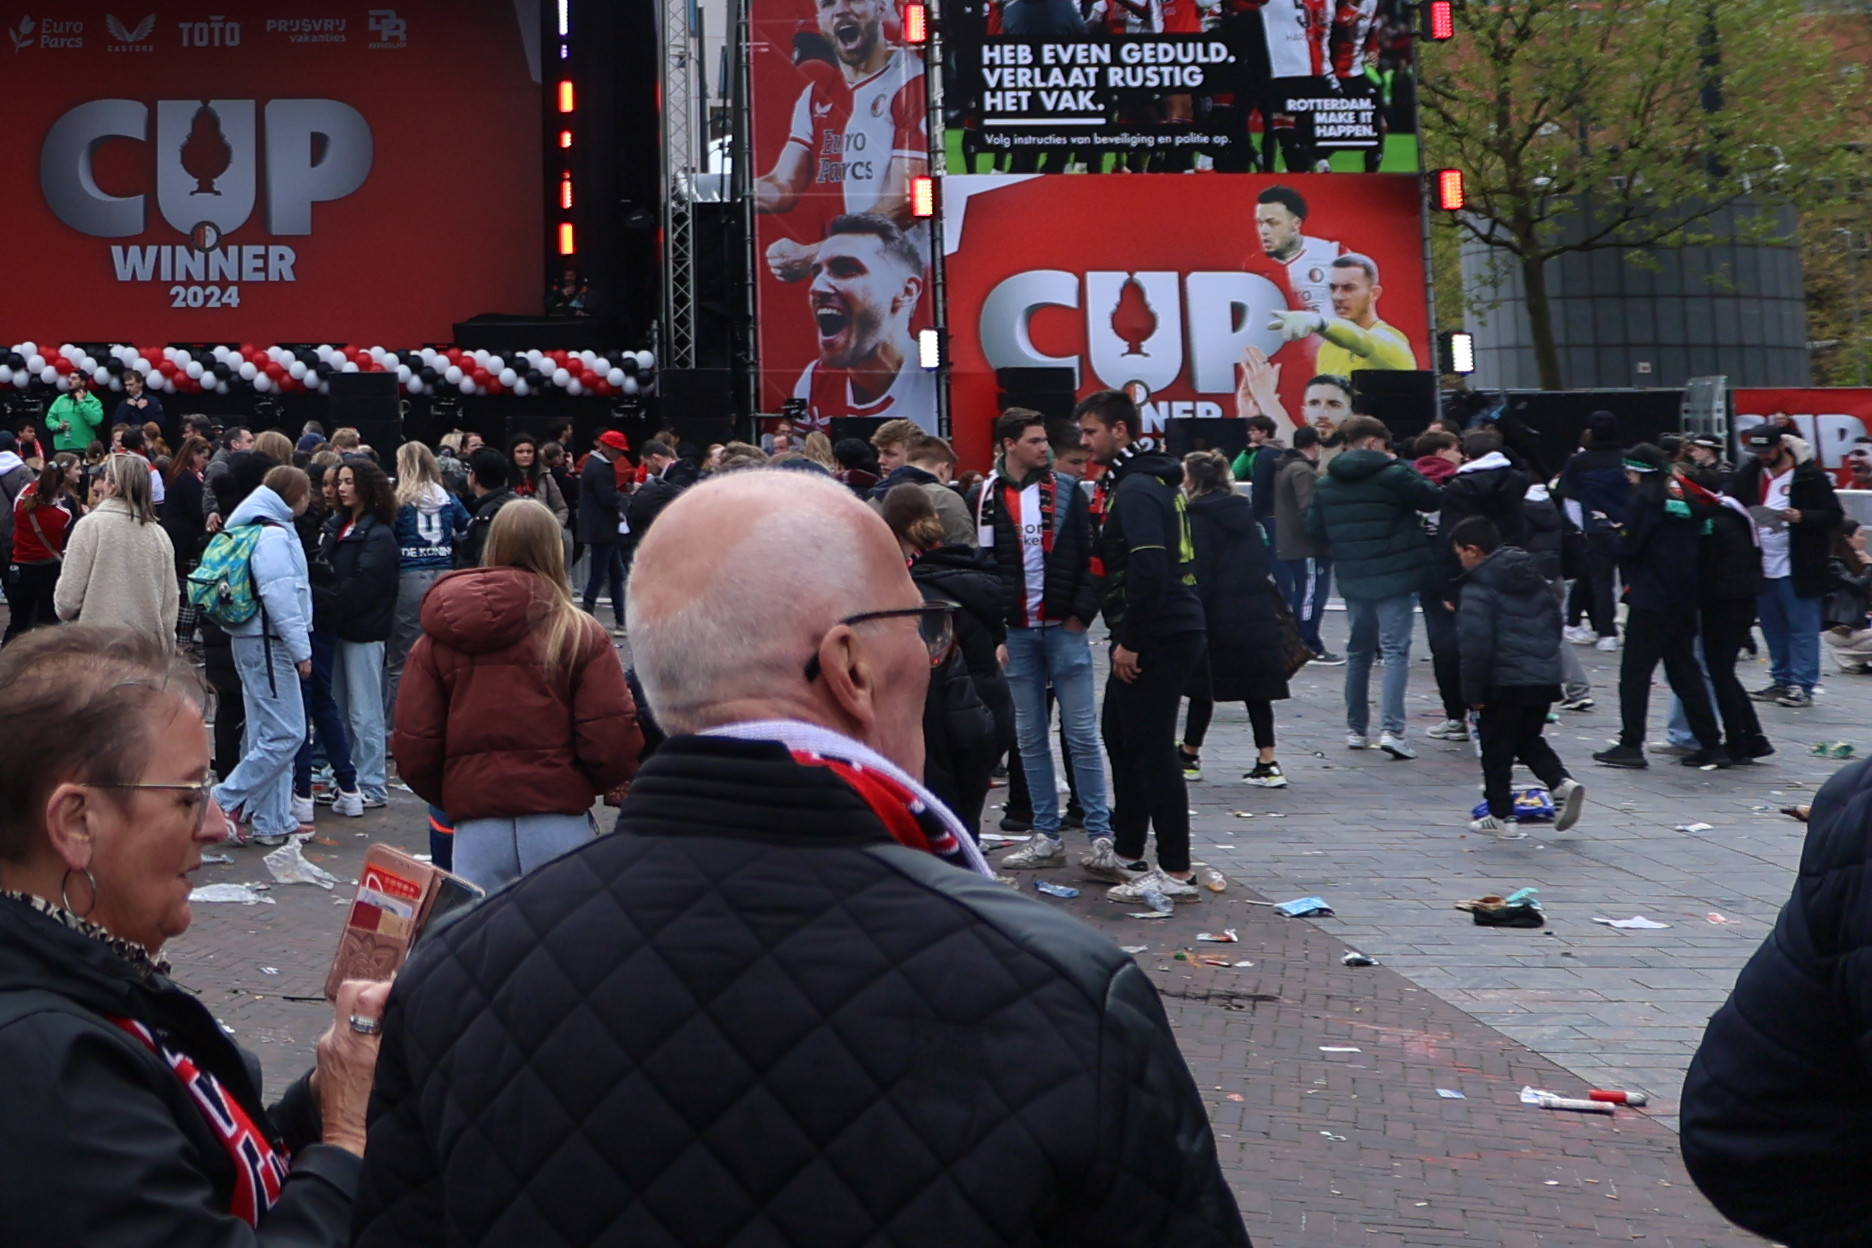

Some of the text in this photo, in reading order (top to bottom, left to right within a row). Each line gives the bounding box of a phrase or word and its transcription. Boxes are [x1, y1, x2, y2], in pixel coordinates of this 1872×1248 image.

[40, 18, 84, 35] Euro
[39, 34, 84, 49] Parcs
[289, 32, 347, 44] vakanties
[982, 42, 1236, 65] HEB EVEN GEDULD.
[982, 65, 1204, 88] VERLAAT RUSTIG
[984, 90, 1105, 112] HET VAK.
[1286, 98, 1376, 112] ROTTERDAM.
[1314, 111, 1374, 124] MAKE IT
[820, 128, 867, 155] Euro
[985, 133, 1011, 147] Volg
[1013, 133, 1068, 145] instructies
[1071, 135, 1091, 145] van
[1094, 132, 1155, 147] beveiliging
[1158, 135, 1172, 145] en
[1175, 132, 1210, 147] politie
[1315, 124, 1378, 137] HAPPEN.
[40, 98, 374, 238] CUP
[815, 157, 874, 184] Parcs
[110, 245, 297, 282] WINNER
[170, 286, 240, 308] 2024
[979, 269, 1288, 395] CUP
